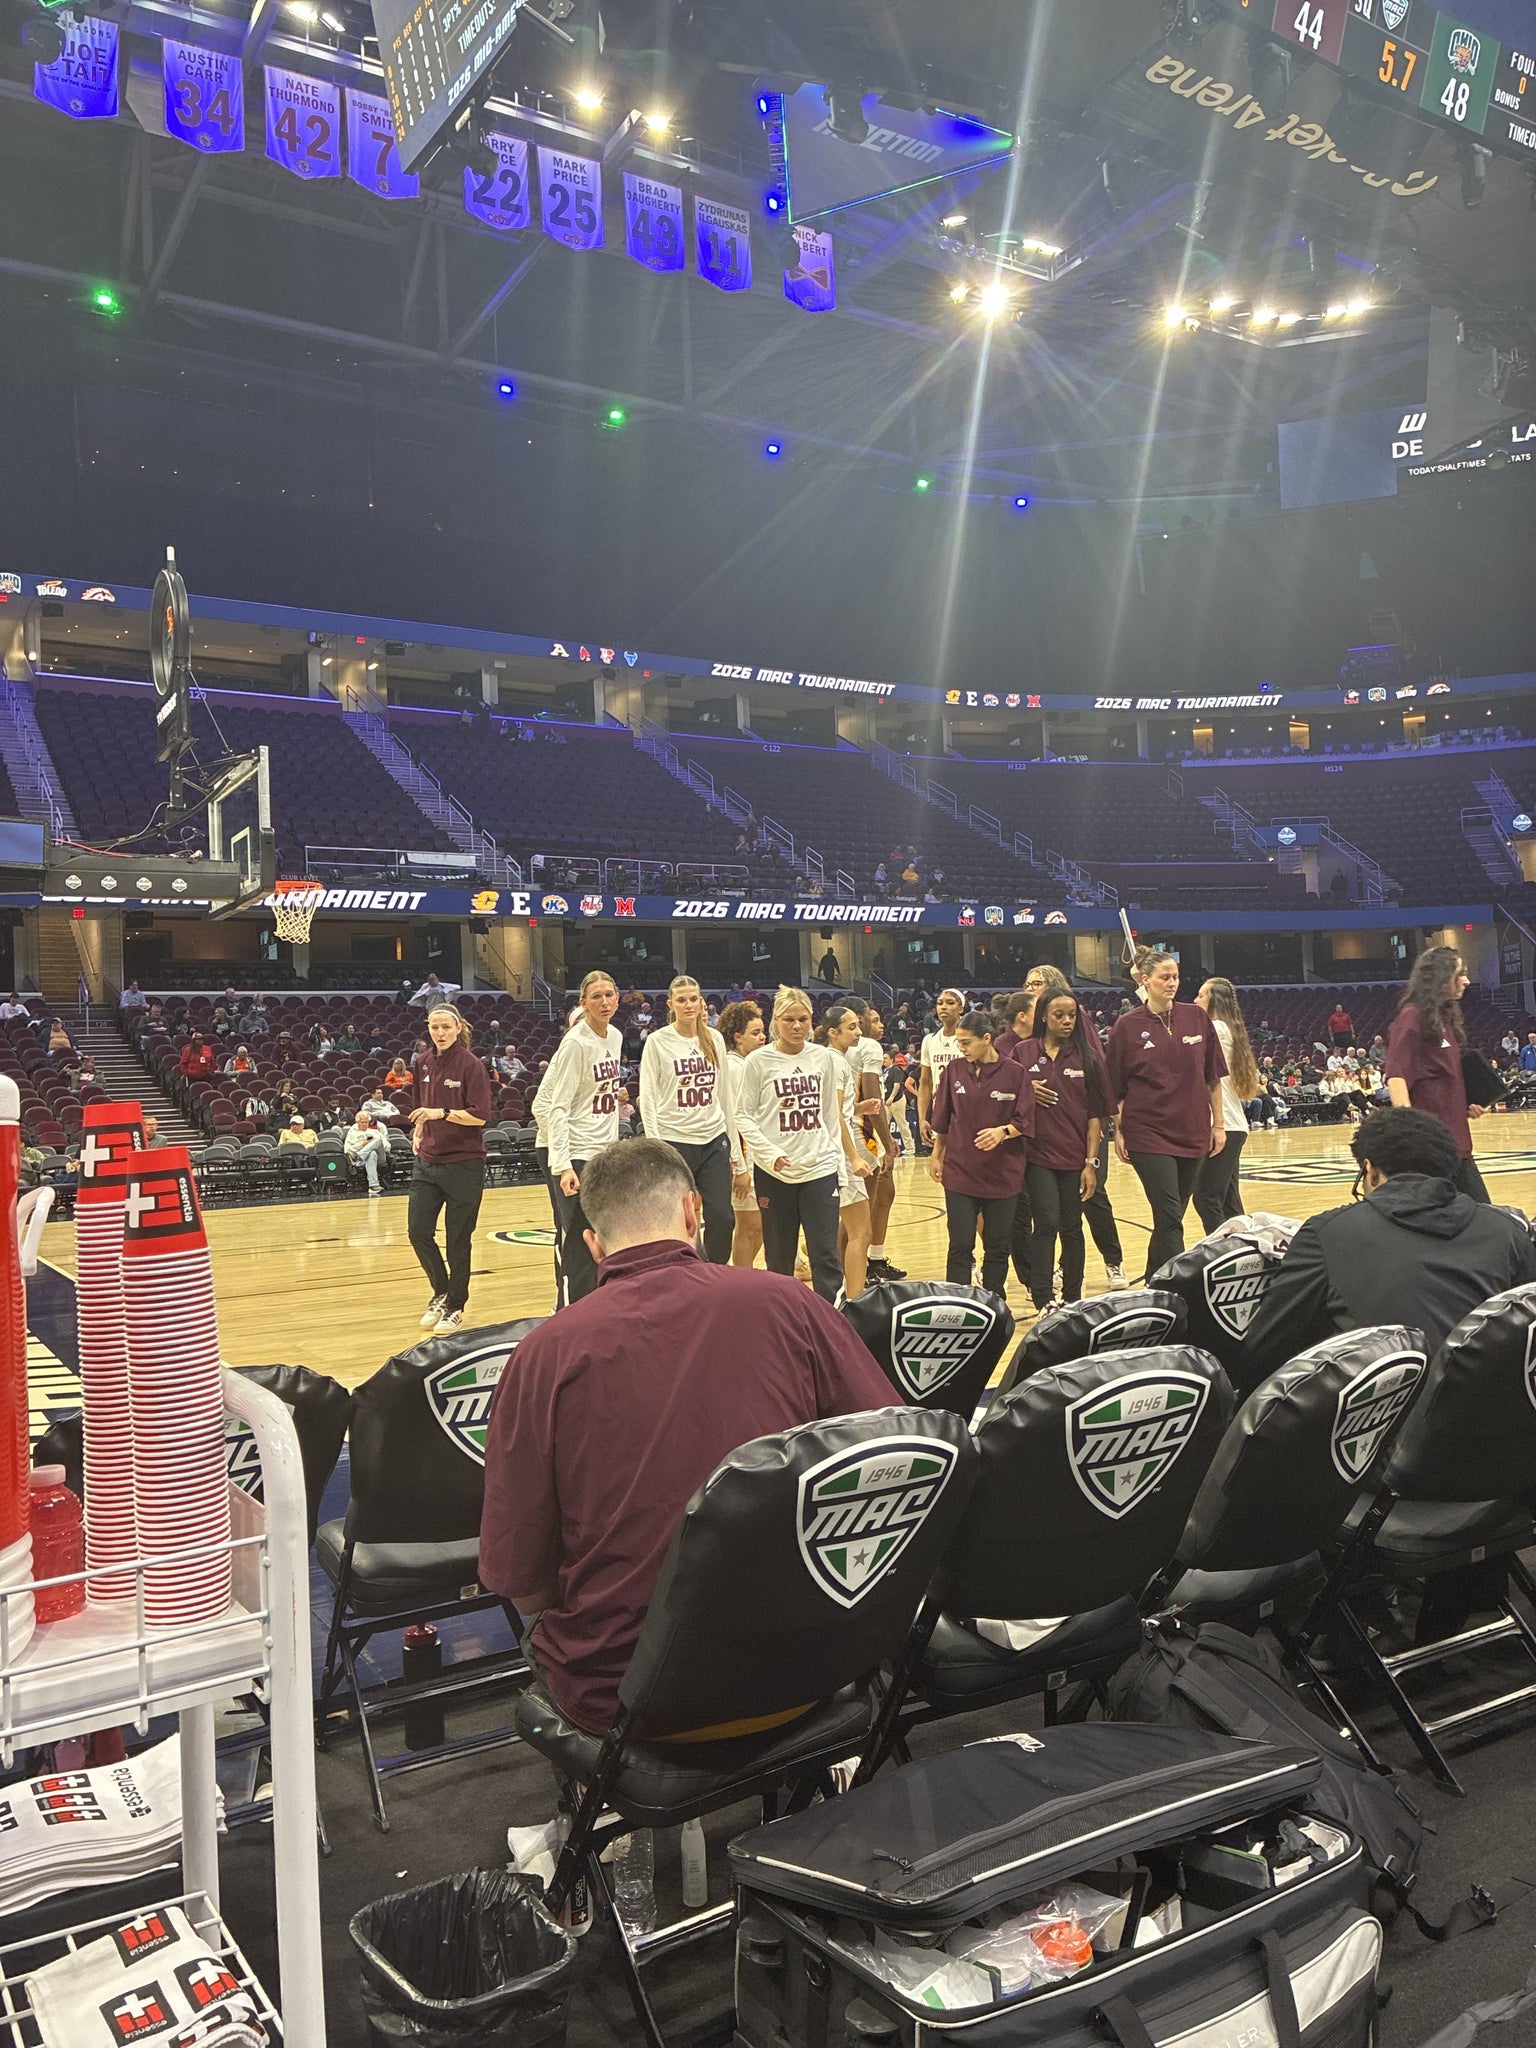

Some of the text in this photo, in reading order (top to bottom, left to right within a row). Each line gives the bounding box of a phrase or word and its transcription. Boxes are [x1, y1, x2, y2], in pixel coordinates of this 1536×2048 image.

[443, 0, 462, 33] 3PT%
[1384, 1, 1404, 16] MAC
[61, 19, 111, 40] SEASONS
[458, 0, 496, 54] TIMEOUTS:
[1293, 0, 1325, 50] 44
[67, 41, 107, 66] JOE
[177, 49, 229, 72] AUSTIN
[62, 58, 109, 85] TAIT
[185, 64, 224, 84] CARR
[1378, 40, 1417, 91] 5.7
[1510, 51, 1536, 80] FOUL
[285, 77, 319, 97] NATE
[447, 64, 472, 107] 2026
[1145, 54, 1266, 130] Arena
[1518, 76, 1527, 95] 0
[174, 78, 236, 136] 34
[268, 86, 335, 114] THURMOND
[352, 100, 378, 113] BOBBY
[1440, 77, 1470, 122] 48
[1494, 88, 1521, 111] BONUS
[361, 112, 393, 130] SMIT
[274, 106, 332, 162] 42
[486, 137, 515, 154] ARRY
[1508, 122, 1536, 149] TIMEO
[371, 130, 394, 177] 7
[553, 156, 588, 174] MARK
[553, 168, 588, 187] PRICE
[472, 168, 523, 214] 22
[638, 182, 668, 199] BRAD
[548, 183, 597, 234] 25
[626, 190, 681, 216] DAUGHERTY
[698, 201, 747, 224] ZYDRUNAS
[631, 208, 679, 257] 43
[698, 212, 748, 235] ILGAUSKAS
[794, 227, 818, 244] NICK
[707, 231, 742, 276] 11
[799, 240, 827, 257] LBERT
[1391, 423, 1536, 459] DE LA
[1507, 453, 1531, 463] TATS
[36, 584, 68, 598] TOLEDO
[711, 663, 895, 696] 2026 MAC TOURNAMENT
[966, 691, 978, 707] E
[1026, 694, 1042, 708] M
[1094, 694, 1283, 710] 2026 MAC TOURNAMENT
[254, 889, 427, 910] URNAMENT
[511, 892, 531, 915] E
[614, 897, 637, 917] M
[672, 900, 926, 923] 2026 MAC TOURNAMENT
[1014, 913, 1036, 926] TOLEDO
[696, 1074, 714, 1085] ON
[773, 1074, 822, 1098] LEGACY
[801, 1096, 819, 1107] ON
[779, 1108, 822, 1132] LOCK
[132, 1131, 143, 1151] esse
[178, 1177, 193, 1222] essentia
[1239, 1260, 1262, 1272] 1946
[1211, 1276, 1270, 1303] MAC
[935, 1313, 961, 1325] 1946
[895, 1331, 979, 1354] MAC
[1127, 1395, 1164, 1415] 1946
[1335, 1385, 1414, 1440] MAC
[1075, 1412, 1192, 1465] MAC
[865, 1464, 907, 1484] 1946
[802, 1483, 937, 1542] MAC
[112, 1767, 144, 1807] essentia
[574, 1878, 584, 1907] esse
[129, 1935, 170, 1956] essentia
[124, 2019, 168, 2039] essentia
